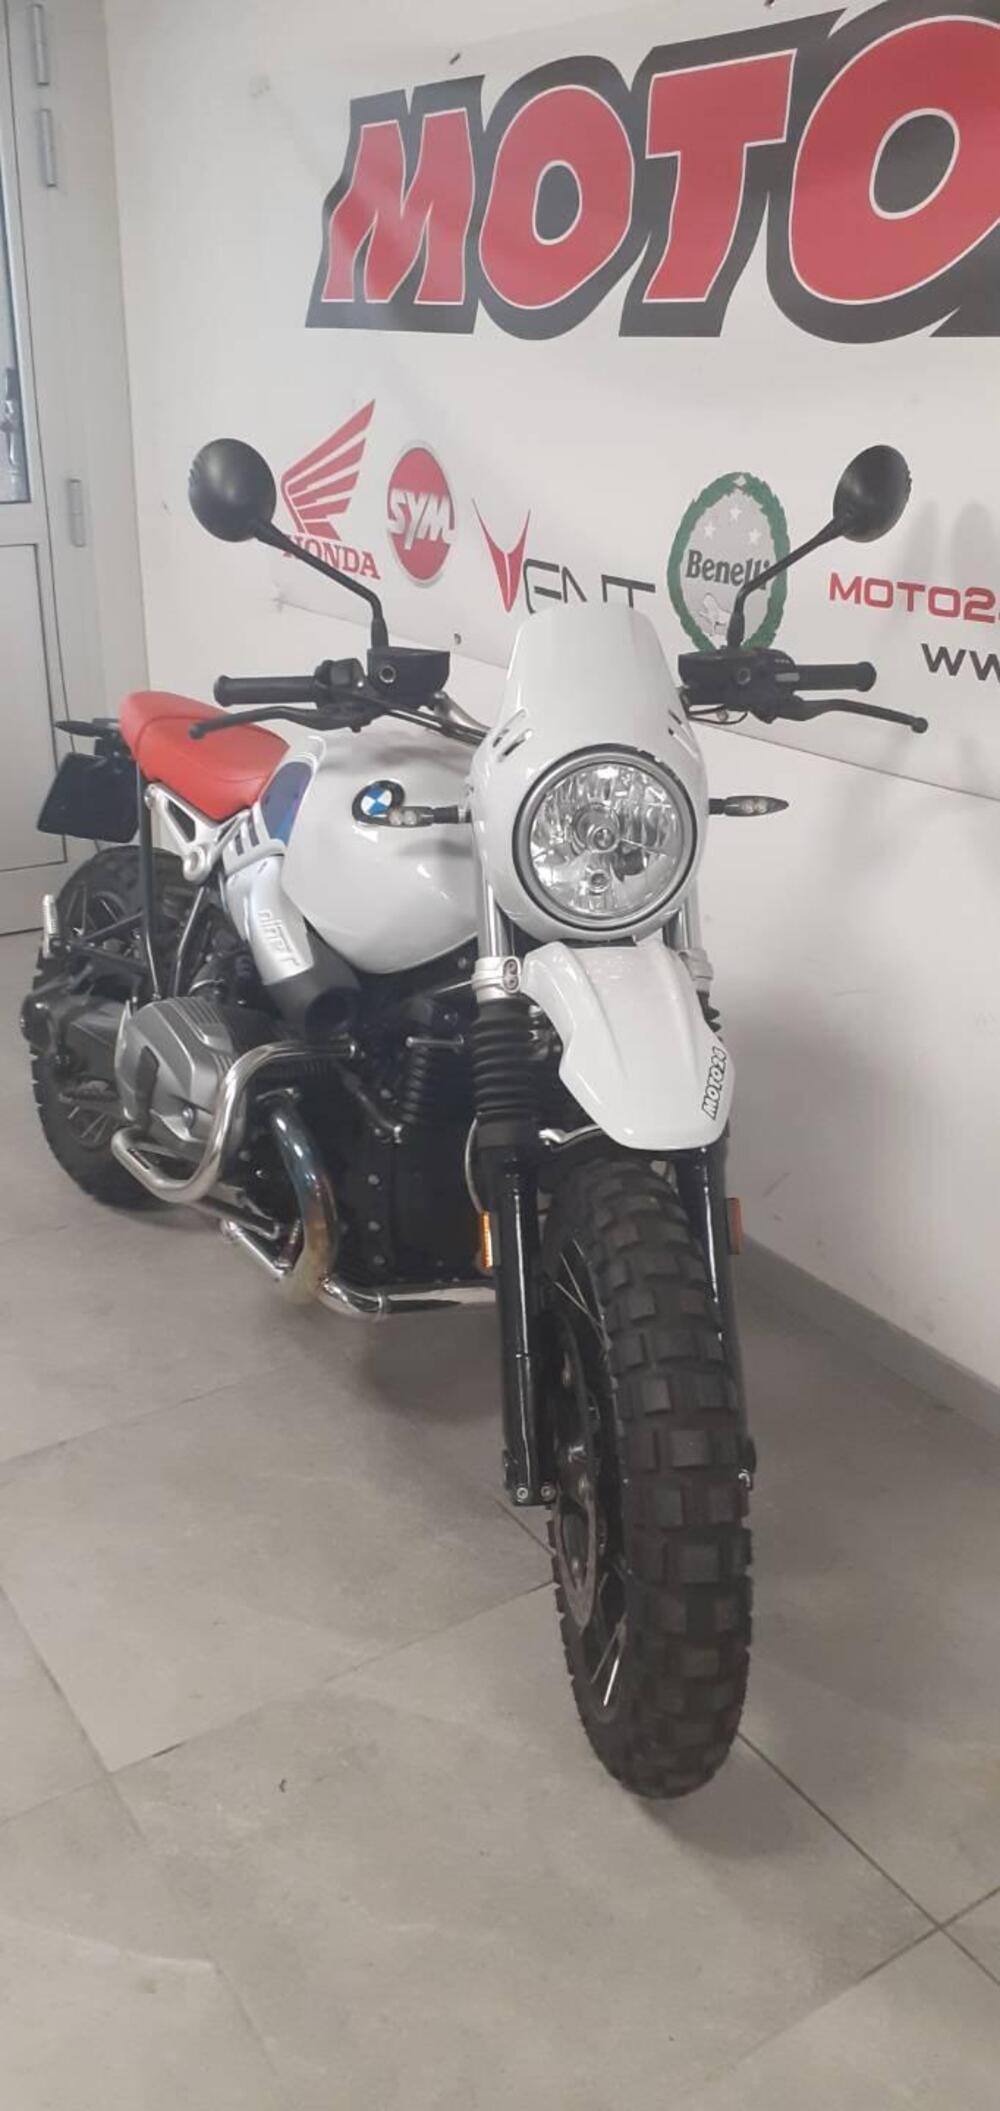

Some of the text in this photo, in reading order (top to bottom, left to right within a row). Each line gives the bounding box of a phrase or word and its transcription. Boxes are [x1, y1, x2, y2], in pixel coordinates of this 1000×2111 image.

[318, 12, 1000, 309] MOTO
[386, 487, 456, 551] SYM
[829, 572, 1000, 624] MOTO2
